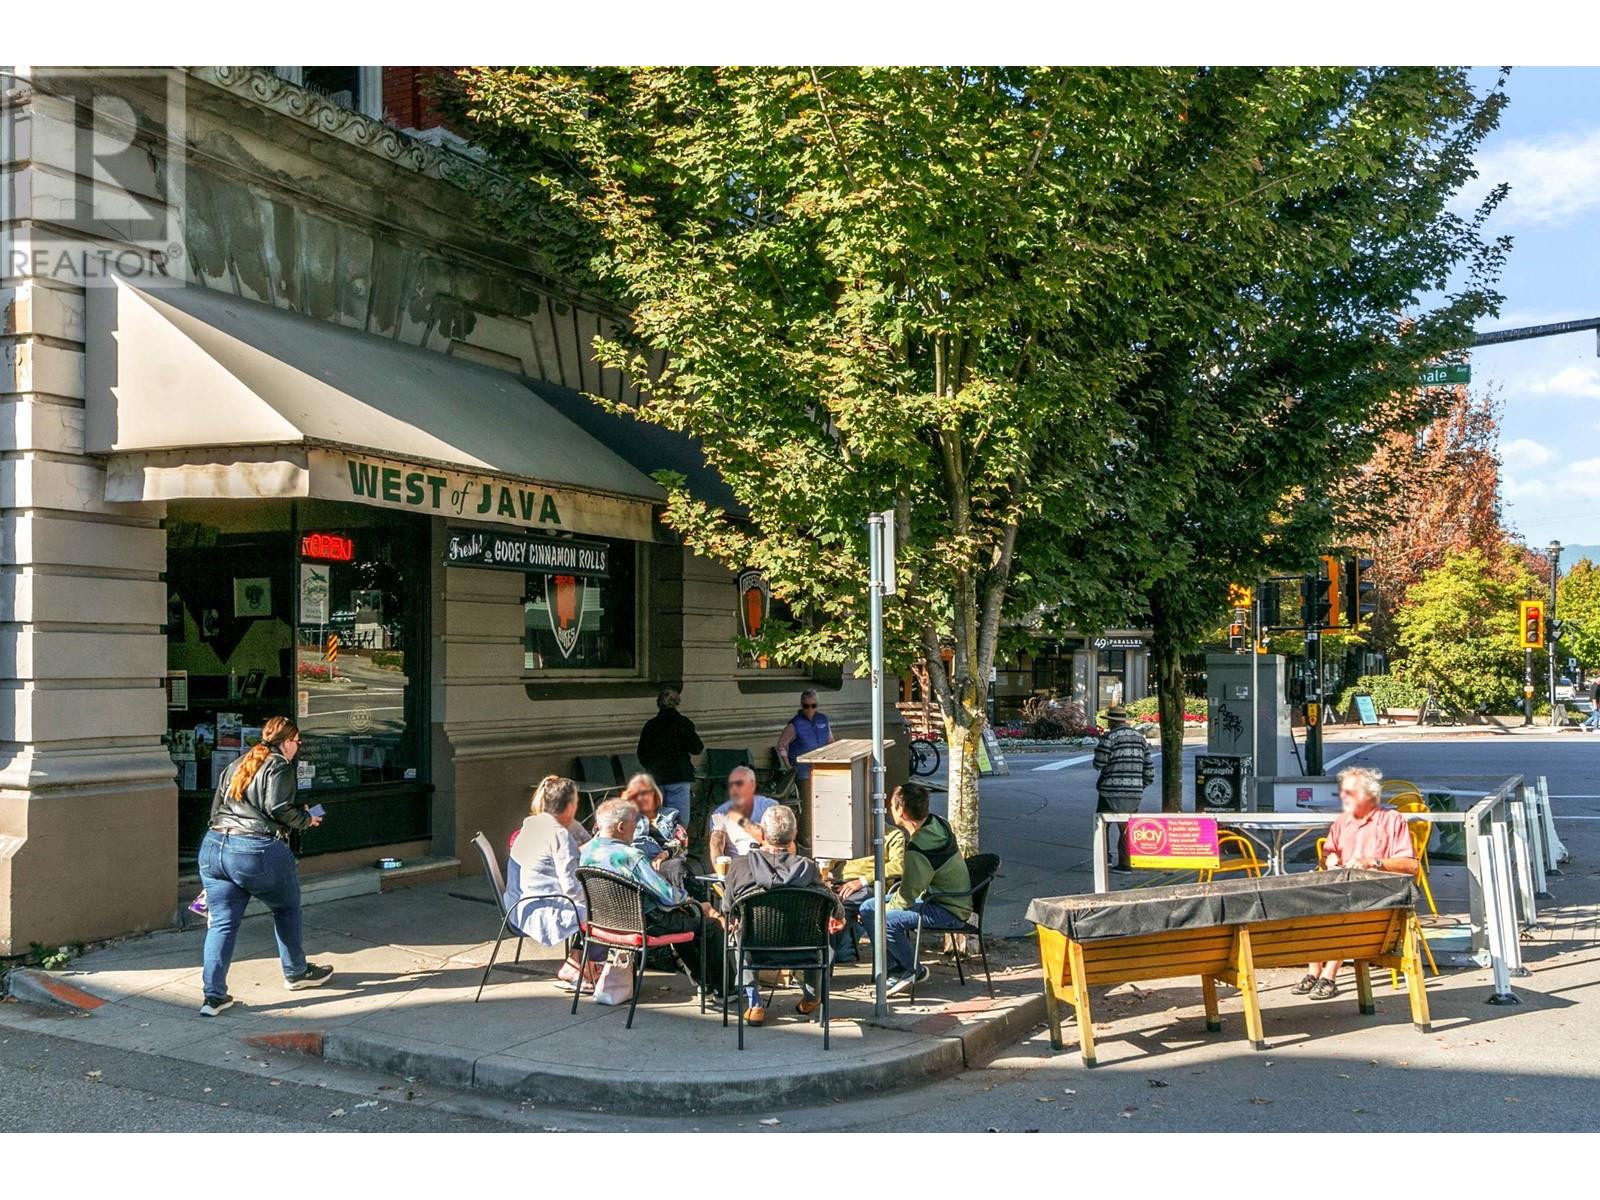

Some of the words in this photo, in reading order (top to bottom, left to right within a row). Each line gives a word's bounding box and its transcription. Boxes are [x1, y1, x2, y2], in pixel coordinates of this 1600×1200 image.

[348, 460, 447, 509] WEST
[451, 481, 474, 515] of
[477, 484, 561, 524] JAVA
[309, 534, 352, 560] OPEN
[449, 534, 483, 561] Fresh!
[494, 540, 527, 563] GOOEY
[529, 543, 576, 567] CINNAMON
[578, 549, 606, 571] ROLLS
[1094, 638, 1107, 649] 49
[1133, 827, 1163, 844] play
